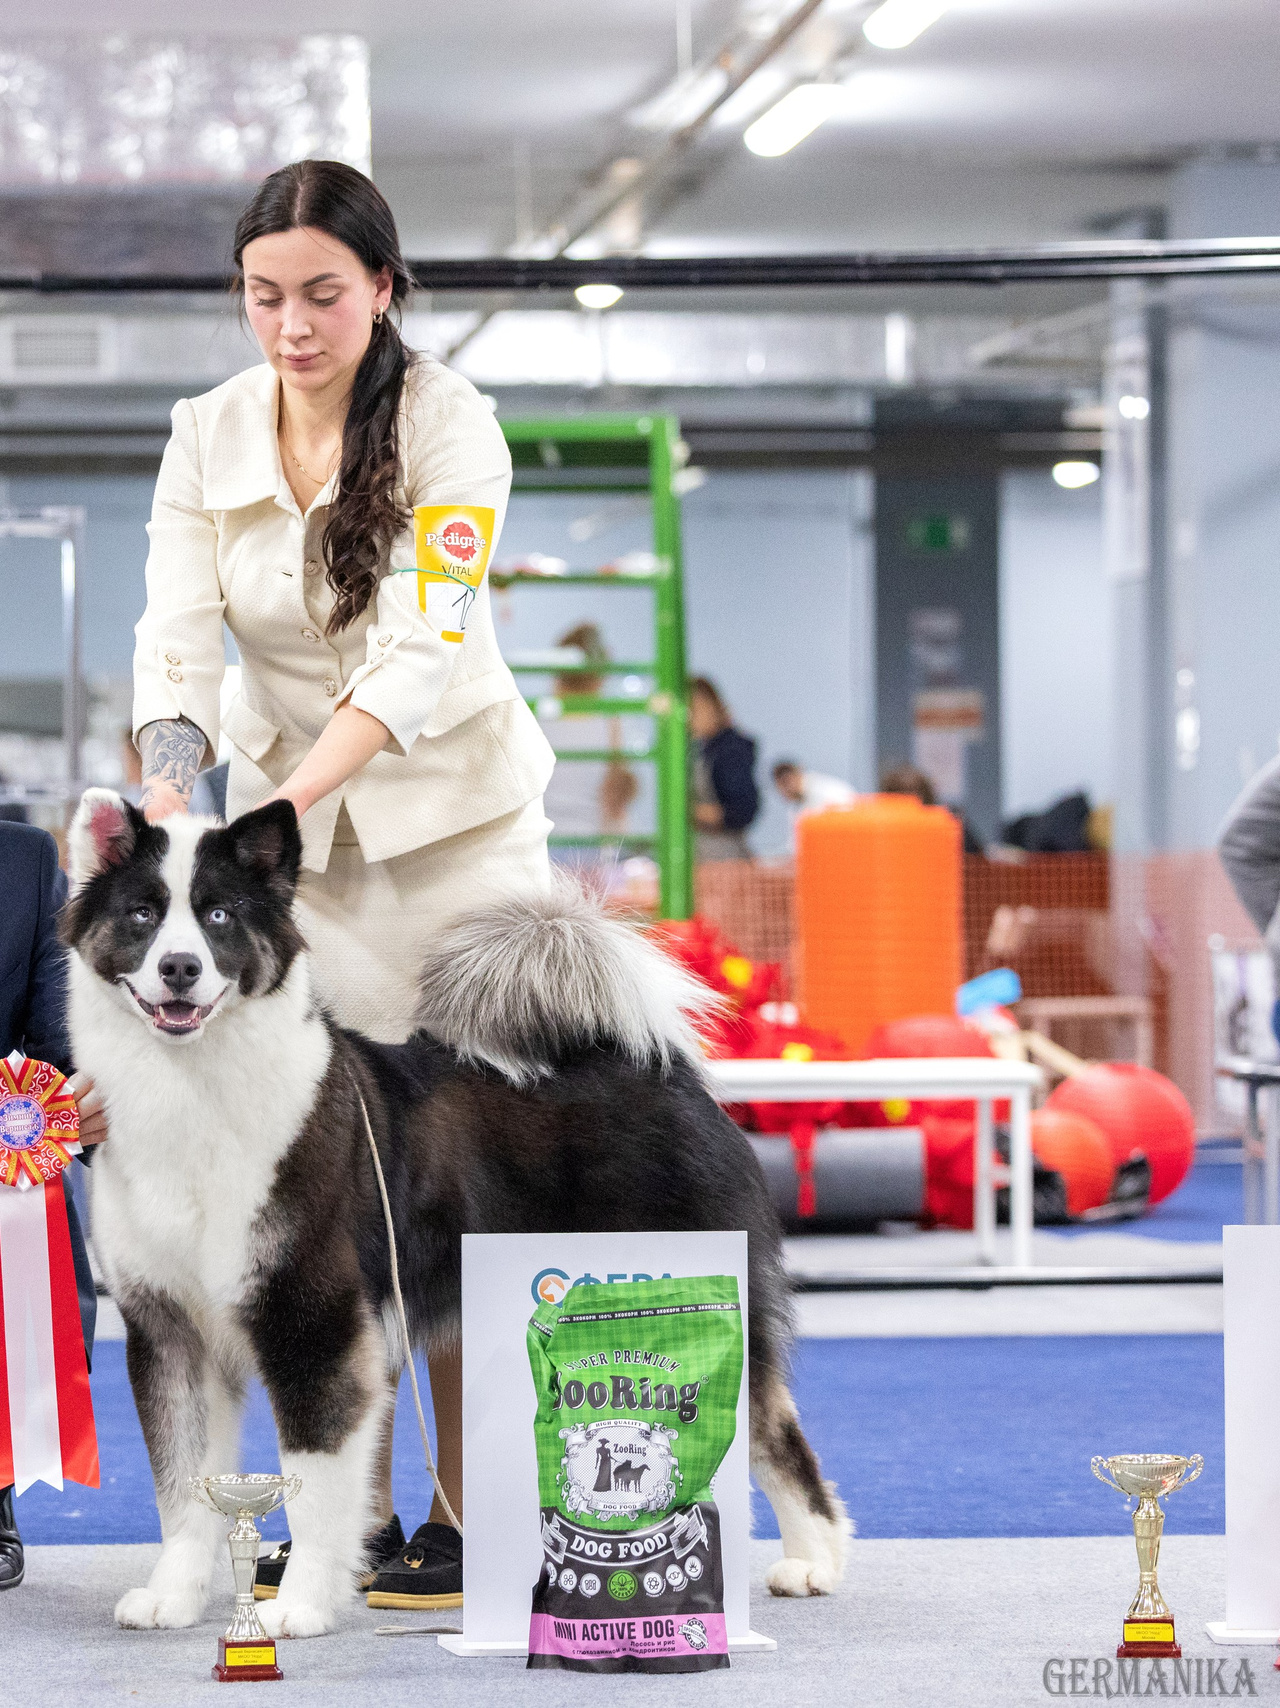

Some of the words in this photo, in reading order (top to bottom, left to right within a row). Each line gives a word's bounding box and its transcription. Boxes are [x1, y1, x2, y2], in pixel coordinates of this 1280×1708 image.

[425, 531, 486, 549] Pedigree
[441, 562, 472, 577] VITAL
[563, 1352, 608, 1371] SUPER
[613, 1350, 681, 1372] PREMIUM
[613, 1443, 647, 1457] ZooRing
[571, 1535, 612, 1558] DOG
[618, 1532, 667, 1558] FOOD
[554, 1621, 577, 1641] MINI
[582, 1621, 636, 1641] ACTIVE
[643, 1619, 675, 1638] DOG
